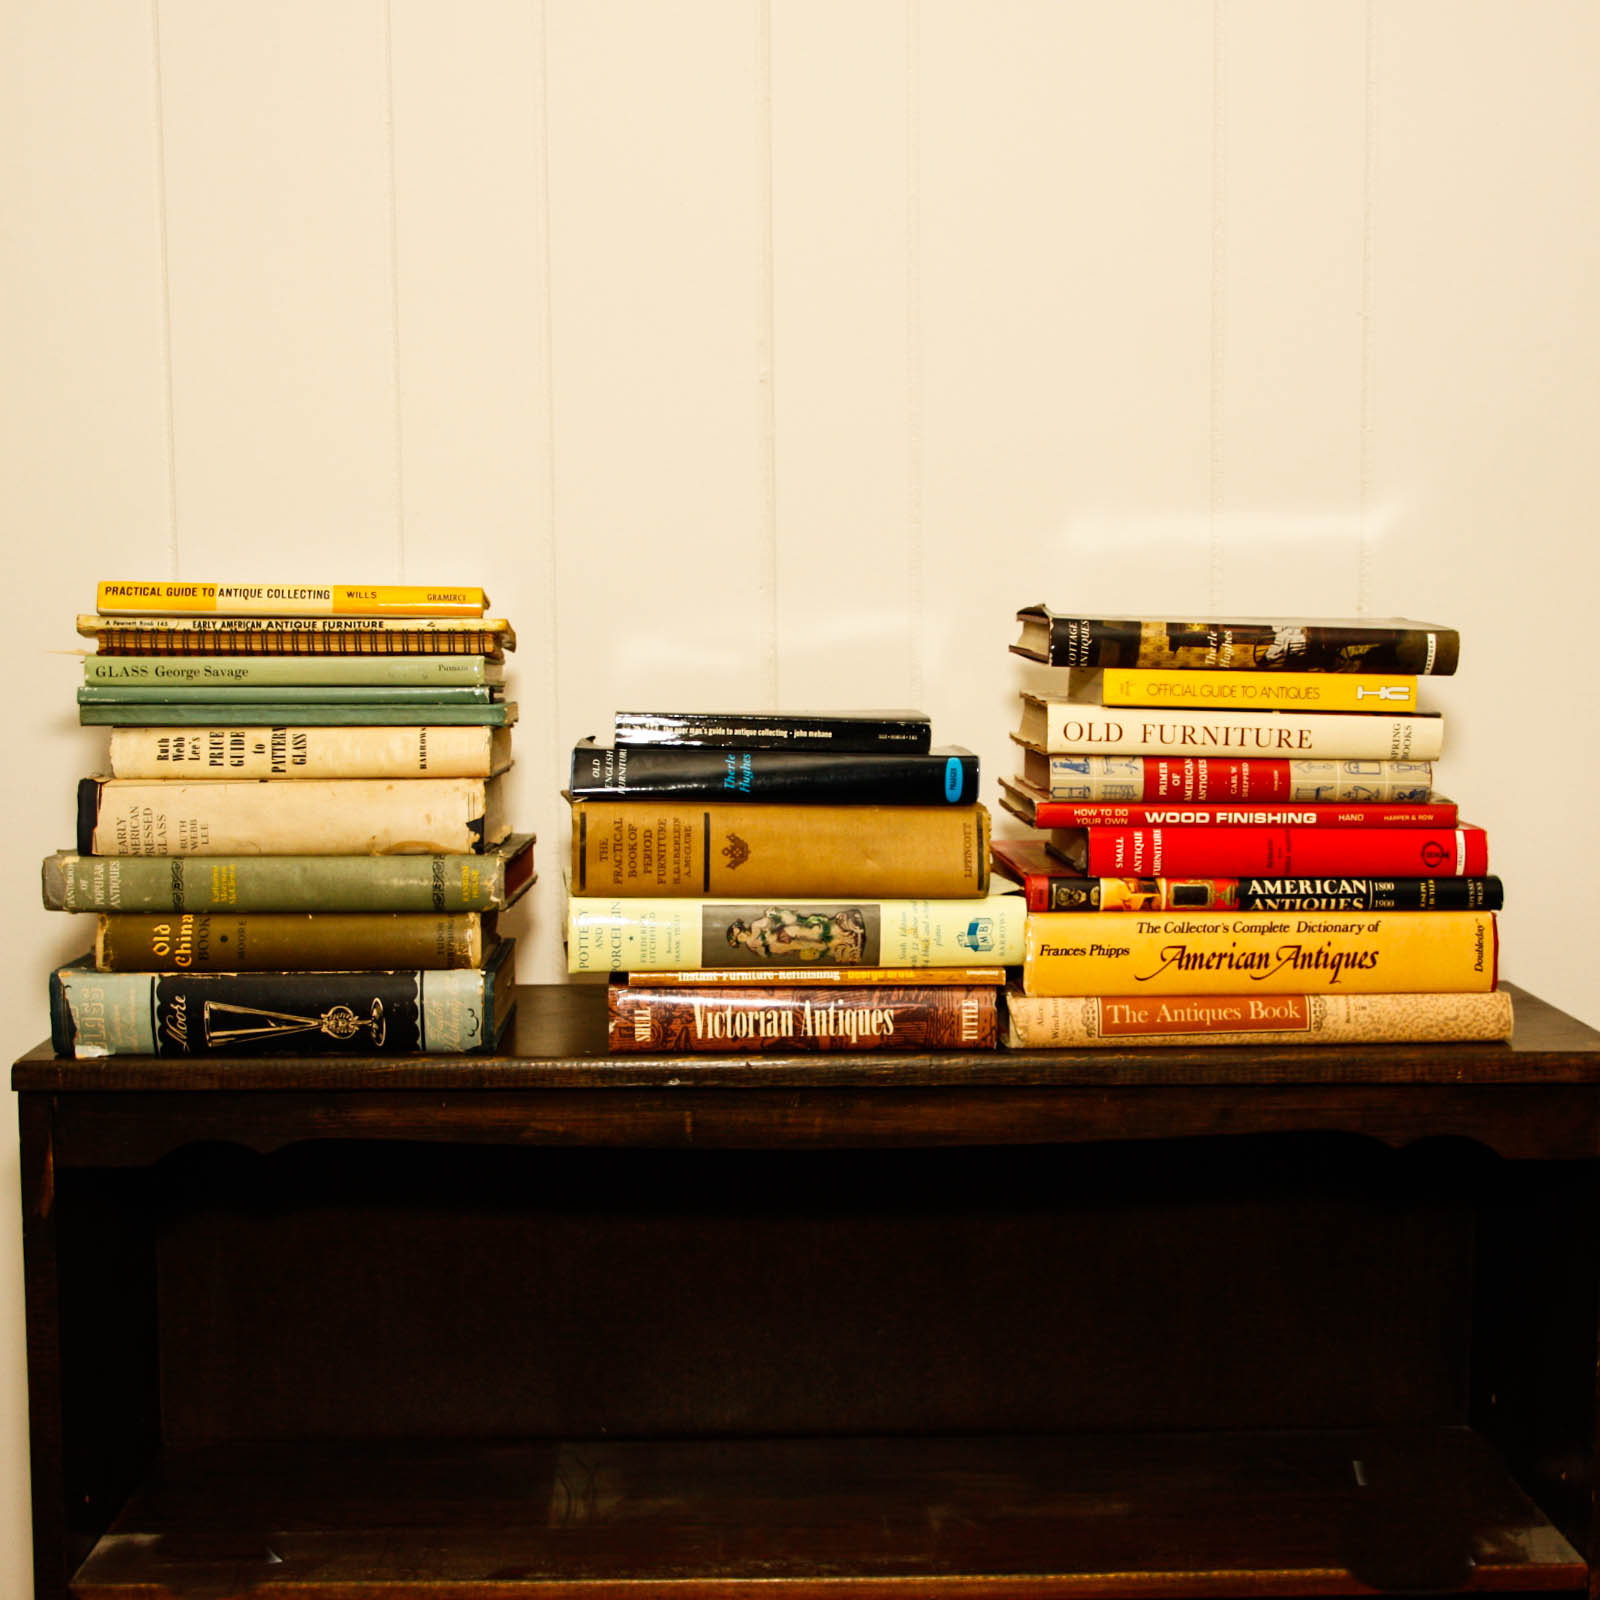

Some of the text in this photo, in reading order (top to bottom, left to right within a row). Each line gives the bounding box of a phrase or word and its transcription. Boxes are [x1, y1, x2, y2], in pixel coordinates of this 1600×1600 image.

[105, 586, 330, 600] PRACTICAL GUIDE TO ANTIQUE COLLECTING
[347, 591, 377, 599] WILLS
[192, 620, 384, 630] EARLY AMERICAN ANTIQUE FURNITURE
[1068, 621, 1078, 667] COTTAGE
[1204, 630, 1218, 666] Therle
[1219, 630, 1233, 669] Hughes
[96, 664, 249, 680] GLASS George Savage
[1146, 683, 1320, 700] OFFICIAL GUIDE TO ANTIQUES
[157, 737, 170, 761] Ruth
[172, 737, 185, 762] Webb
[188, 736, 201, 761] Lee's
[209, 731, 225, 767] PRICE
[230, 731, 245, 767] GUIDE
[252, 743, 266, 754] to
[292, 733, 307, 765] GLASS
[708, 727, 726, 736] guide
[727, 727, 733, 735] to
[734, 728, 757, 737] antique
[758, 728, 788, 738] collecting
[793, 729, 807, 739] john
[1063, 720, 1313, 749] OLD FURNITURE
[1391, 723, 1401, 760] SPRING
[1401, 724, 1413, 760] BOOKS
[592, 758, 601, 779] OLD
[604, 750, 614, 789] ENGLISH
[723, 753, 737, 789] Therle
[739, 753, 756, 793] Hughes
[1159, 762, 1169, 796] PRIMER
[1171, 773, 1181, 787] OF
[1184, 758, 1194, 802] AMERICAN
[1198, 758, 1208, 801] ANTIQUES
[1074, 808, 1129, 817] HOW TO DO
[1076, 817, 1128, 825] YOUR OWN
[1144, 811, 1317, 824] WOOD FINISHING
[1338, 813, 1364, 822] HAND
[1384, 814, 1410, 822] HARPER
[116, 816, 129, 857] EARLY
[129, 805, 141, 857] MERICAN
[179, 819, 188, 849] RUTH
[190, 818, 199, 851] WEBB
[200, 823, 210, 845] LEE
[599, 838, 609, 862] THE
[613, 817, 624, 885] PRACTICAL
[628, 823, 638, 879] BOOK OF
[643, 829, 653, 875] PERIOD
[657, 817, 667, 885] FURNITURE
[963, 822, 973, 879] LIPPINCOTT
[1116, 836, 1125, 869] SMALL
[1134, 831, 1145, 873] ANTIQUE
[1153, 828, 1163, 876] FURNITURE
[80, 879, 88, 891] OF
[94, 863, 105, 905] POPULAR
[109, 860, 121, 908] ANTIQUES
[1248, 879, 1368, 895] AMERICAN
[1374, 881, 1395, 892] 1800
[1250, 897, 1364, 911] ANTIQUES
[1374, 898, 1395, 909] 1900
[151, 924, 171, 957] Old
[175, 914, 194, 968] China
[198, 917, 210, 961] BOOK
[578, 909, 590, 969] POTTEY
[595, 927, 604, 949] AND
[611, 900, 622, 972] ORCEIN
[640, 913, 648, 964] FREDERIK
[649, 911, 657, 964] LITCHFID
[1137, 920, 1382, 935] The Collector's Complete Dictionary of
[1039, 944, 1131, 959] Frances Phipps
[1134, 941, 1380, 985] American Antiques
[1473, 924, 1485, 973] Doubleday
[165, 993, 191, 1055] Moore
[634, 1007, 651, 1042] SHULL
[693, 999, 895, 1044] Victorian Antiques
[961, 999, 979, 1042] TUTTLE
[1105, 1000, 1301, 1026] The Antiques Book
